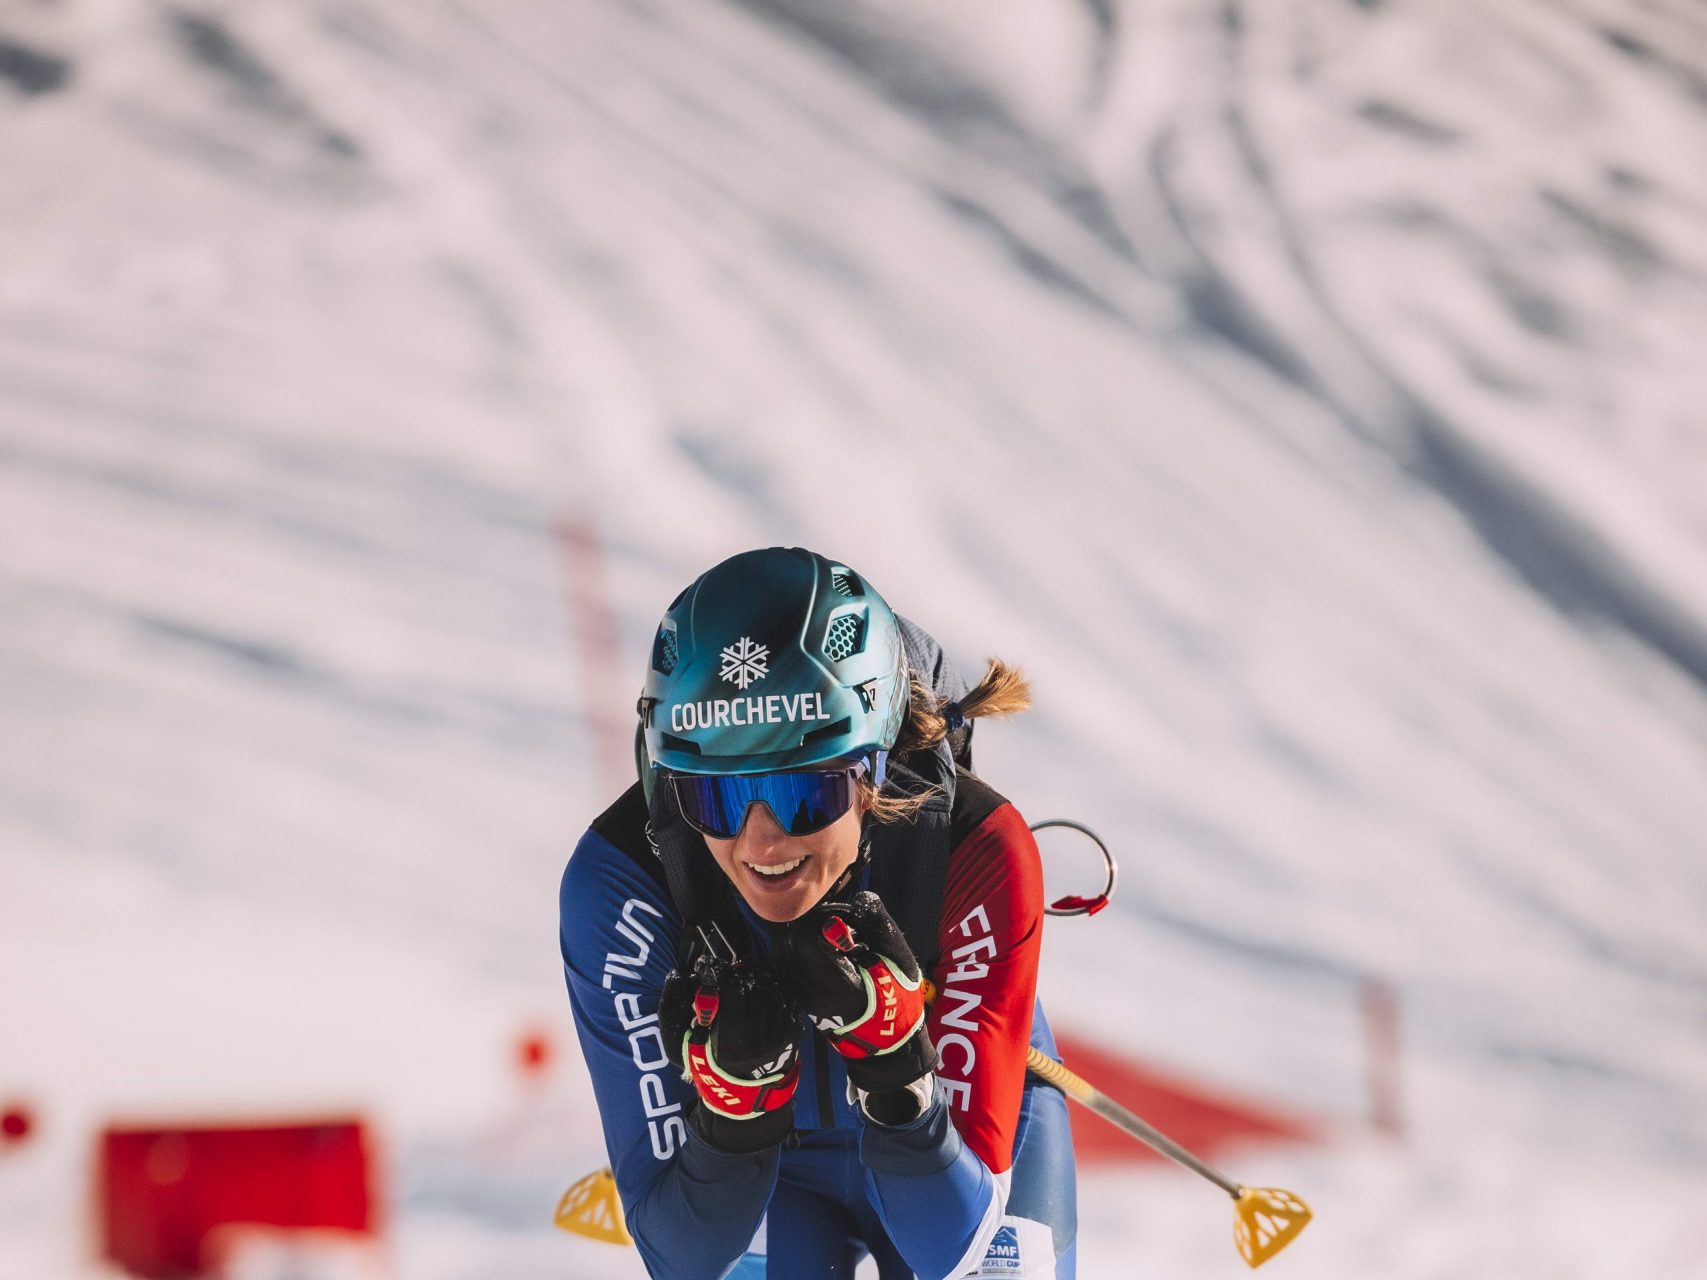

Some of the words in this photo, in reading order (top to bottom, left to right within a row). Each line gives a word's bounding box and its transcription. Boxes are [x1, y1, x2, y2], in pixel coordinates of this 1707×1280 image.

[671, 692, 831, 732] COURCHEVEL
[879, 976, 898, 1037] LEKI
[691, 1054, 742, 1107] LEKI
[982, 1260, 1006, 1268] WORLD
[986, 1244, 1018, 1257] SMF
